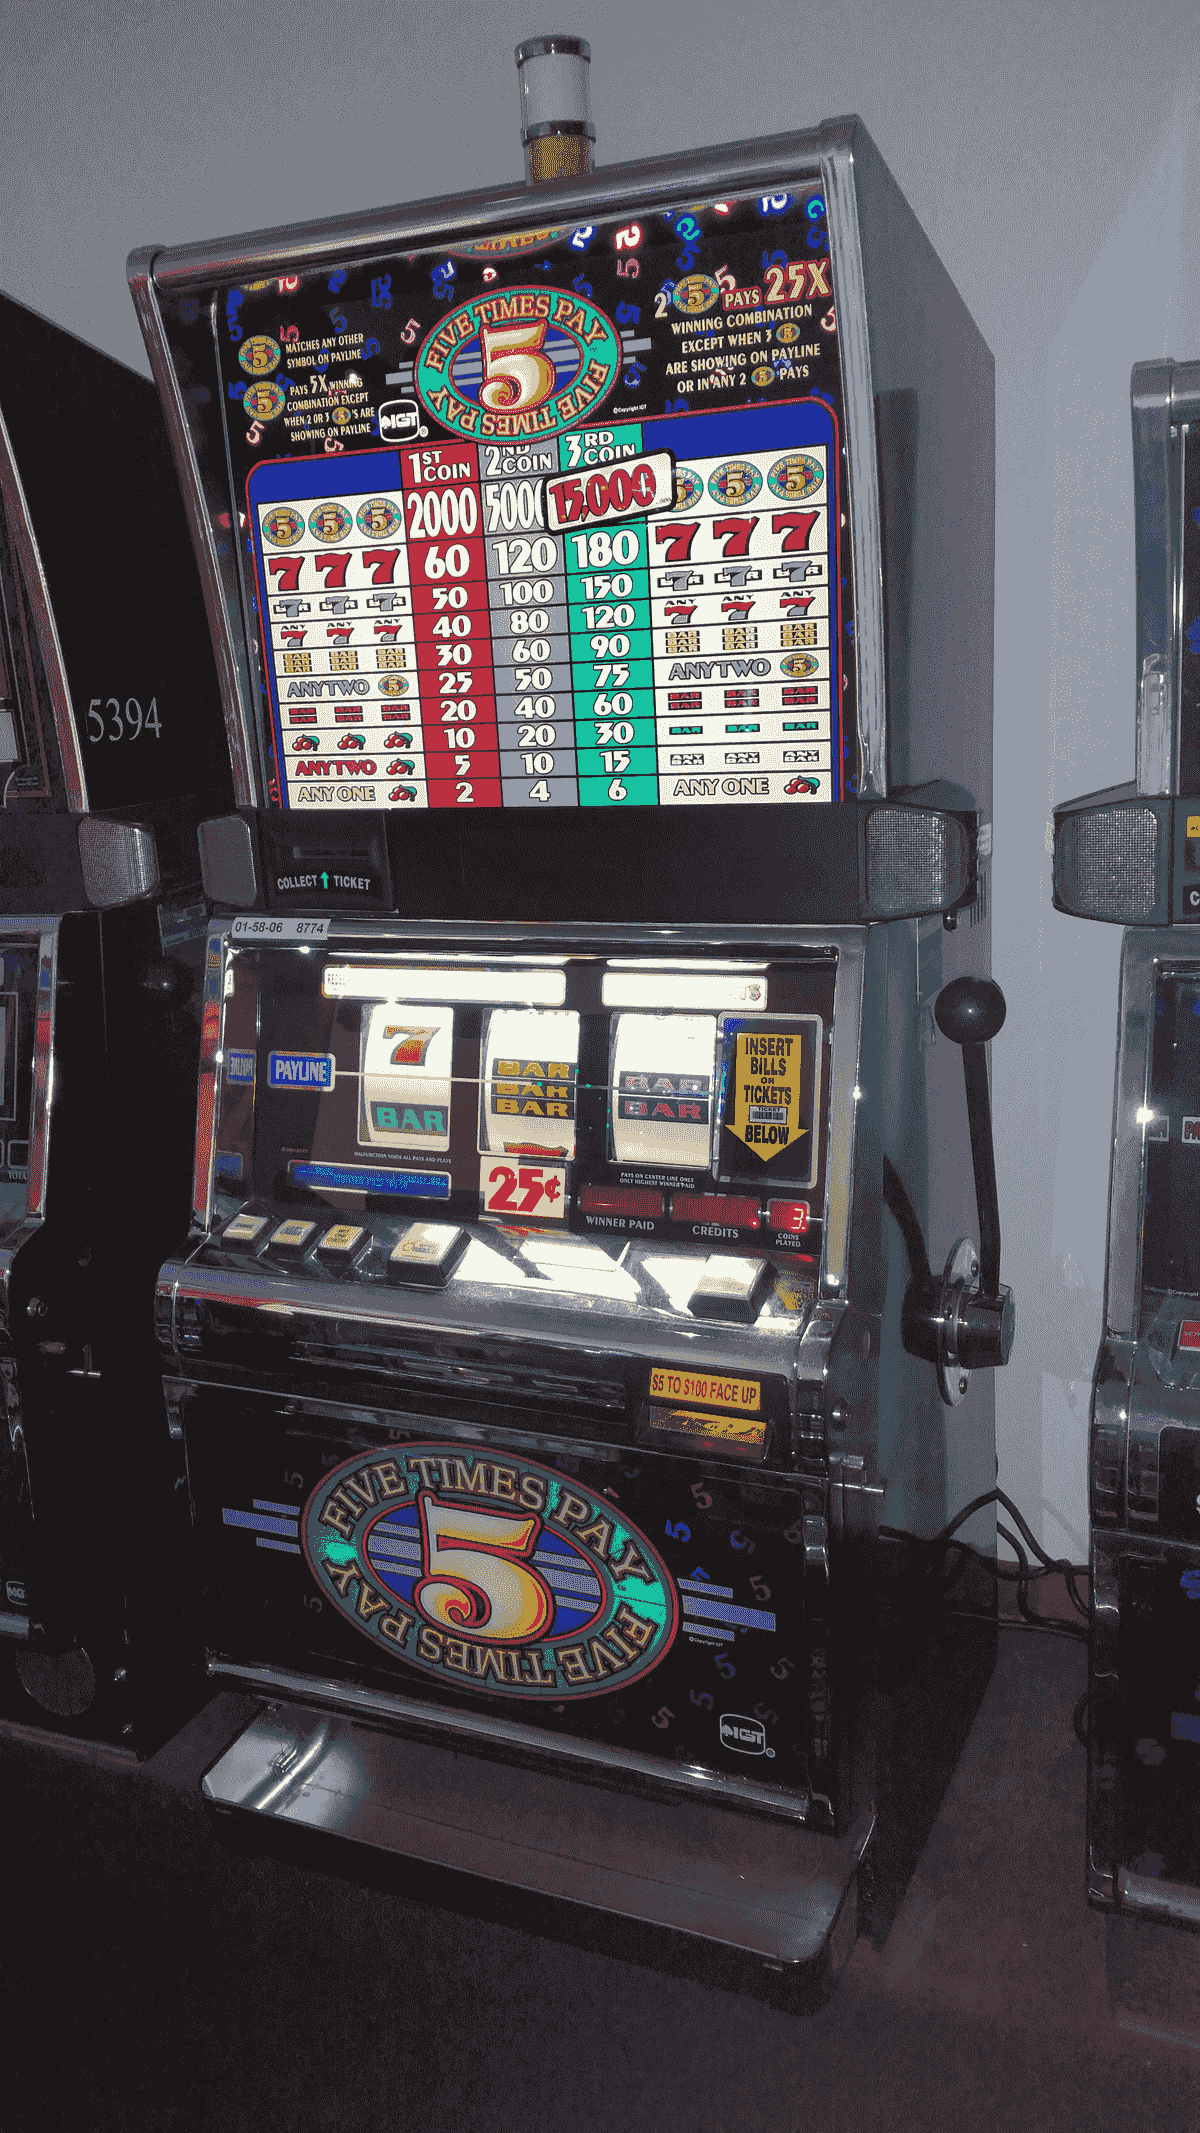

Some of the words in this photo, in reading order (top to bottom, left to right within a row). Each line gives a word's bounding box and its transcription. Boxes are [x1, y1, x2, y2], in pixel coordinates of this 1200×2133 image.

[654, 292, 668, 318] 2
[725, 289, 760, 308] PAYS
[765, 261, 830, 303] 25X
[424, 313, 475, 373] FIVE
[473, 294, 550, 325] TIMES
[553, 298, 609, 345] PAY
[671, 317, 723, 335] WINNING
[726, 304, 813, 328] COMBINATION
[285, 339, 320, 354] MATCHES
[322, 337, 336, 348] ANY
[338, 333, 364, 346] OTHER
[681, 336, 725, 353] EXCEPT
[728, 331, 761, 346] WHEN
[765, 329, 772, 342] 3
[287, 355, 316, 369] SYMBOL
[318, 353, 329, 364] ON
[331, 349, 362, 363] PAYLINE
[479, 318, 556, 415] 5
[665, 360, 688, 375] ARE
[691, 353, 747, 373] SHOWING
[750, 350, 768, 364] ON
[771, 343, 821, 361] PAYLINE
[290, 385, 308, 396] PAYS
[310, 374, 328, 394] 5X
[556, 358, 611, 421] FIVE
[677, 380, 694, 393] OR
[697, 377, 709, 390] IN
[713, 374, 736, 389] ANY
[739, 372, 747, 385] 2
[779, 365, 809, 380] PAYS
[287, 396, 340, 412] COMBINATION
[341, 392, 369, 405] EXCEPT
[427, 384, 480, 433] PAY
[284, 416, 304, 427] WHEN
[306, 414, 312, 424] 2
[313, 413, 323, 424] OR
[360, 407, 375, 418] ARE
[480, 405, 557, 437] TIMES
[290, 428, 325, 442] SHOWING
[327, 427, 339, 437] ON
[340, 423, 371, 435] PAYLINE
[484, 446, 531, 477] 2ND
[565, 430, 614, 468] 3RD
[583, 443, 636, 464] COIN
[407, 450, 443, 484] 1ST
[423, 461, 471, 482] COIN
[501, 453, 552, 474] COIN
[406, 486, 478, 539] 2000
[549, 464, 657, 524] 15,000
[267, 556, 305, 591] 7
[314, 552, 353, 588] 7
[361, 548, 401, 585] 7
[423, 543, 470, 580] 60
[492, 536, 558, 575] 120
[570, 529, 640, 569] 180
[431, 586, 469, 611] 50
[499, 579, 554, 607] 100
[580, 573, 633, 600] 150
[432, 614, 472, 639] 40
[509, 609, 550, 635] 80
[581, 603, 636, 630] 120
[435, 642, 473, 667] 30
[511, 638, 552, 664] 60
[590, 633, 631, 659] 90
[438, 671, 474, 695] 25
[514, 666, 553, 692] 50
[592, 663, 631, 688] 75
[88, 697, 162, 742] 5394
[439, 699, 477, 723] 20
[514, 695, 557, 720] 40
[593, 691, 634, 717] 60
[443, 726, 476, 750] 10
[517, 723, 557, 748] 20
[594, 720, 635, 745] 30
[454, 754, 472, 776] 5
[520, 751, 555, 776] 10
[599, 749, 631, 773] 15
[298, 786, 335, 802] ANY
[337, 785, 376, 802] ONE
[455, 781, 475, 803] 2
[529, 779, 551, 802] 4
[607, 777, 628, 801] 6
[673, 778, 719, 797] ANY
[721, 777, 770, 796] ONE
[277, 874, 318, 890] COLLECT
[333, 875, 371, 891] TICKET
[234, 921, 283, 934] 01-58-06
[296, 922, 324, 934] 8774
[382, 1025, 441, 1067] 7
[745, 1037, 794, 1056] INSERT
[275, 1059, 327, 1083] PAYLINE
[497, 1060, 570, 1078] BAR
[750, 1057, 787, 1076] BILLS
[496, 1098, 569, 1117] BAR
[744, 1085, 792, 1105] TICKETS
[376, 1107, 445, 1132] BAR
[625, 1101, 701, 1119] BAR
[745, 1125, 790, 1145] BELOW
[354, 1151, 387, 1159] MALFUNCTION
[488, 1166, 562, 1213] 25¢
[586, 1215, 628, 1229] WINNER
[629, 1218, 655, 1231] PAID
[692, 1225, 739, 1239] CREDITS
[778, 1232, 799, 1241] COINS
[775, 1239, 801, 1247] PLAYED
[652, 1374, 665, 1392] $5
[668, 1376, 681, 1394] TO
[684, 1378, 707, 1398] $100
[710, 1381, 739, 1402] FACE
[742, 1385, 757, 1404] UP
[320, 1458, 408, 1537] FIVE
[408, 1455, 548, 1512] TIMES
[553, 1490, 654, 1583] PAY
[414, 1490, 553, 1645] 5
[321, 1559, 417, 1645] PAY
[416, 1624, 558, 1688] TIMES
[558, 1601, 658, 1687] FIVE
